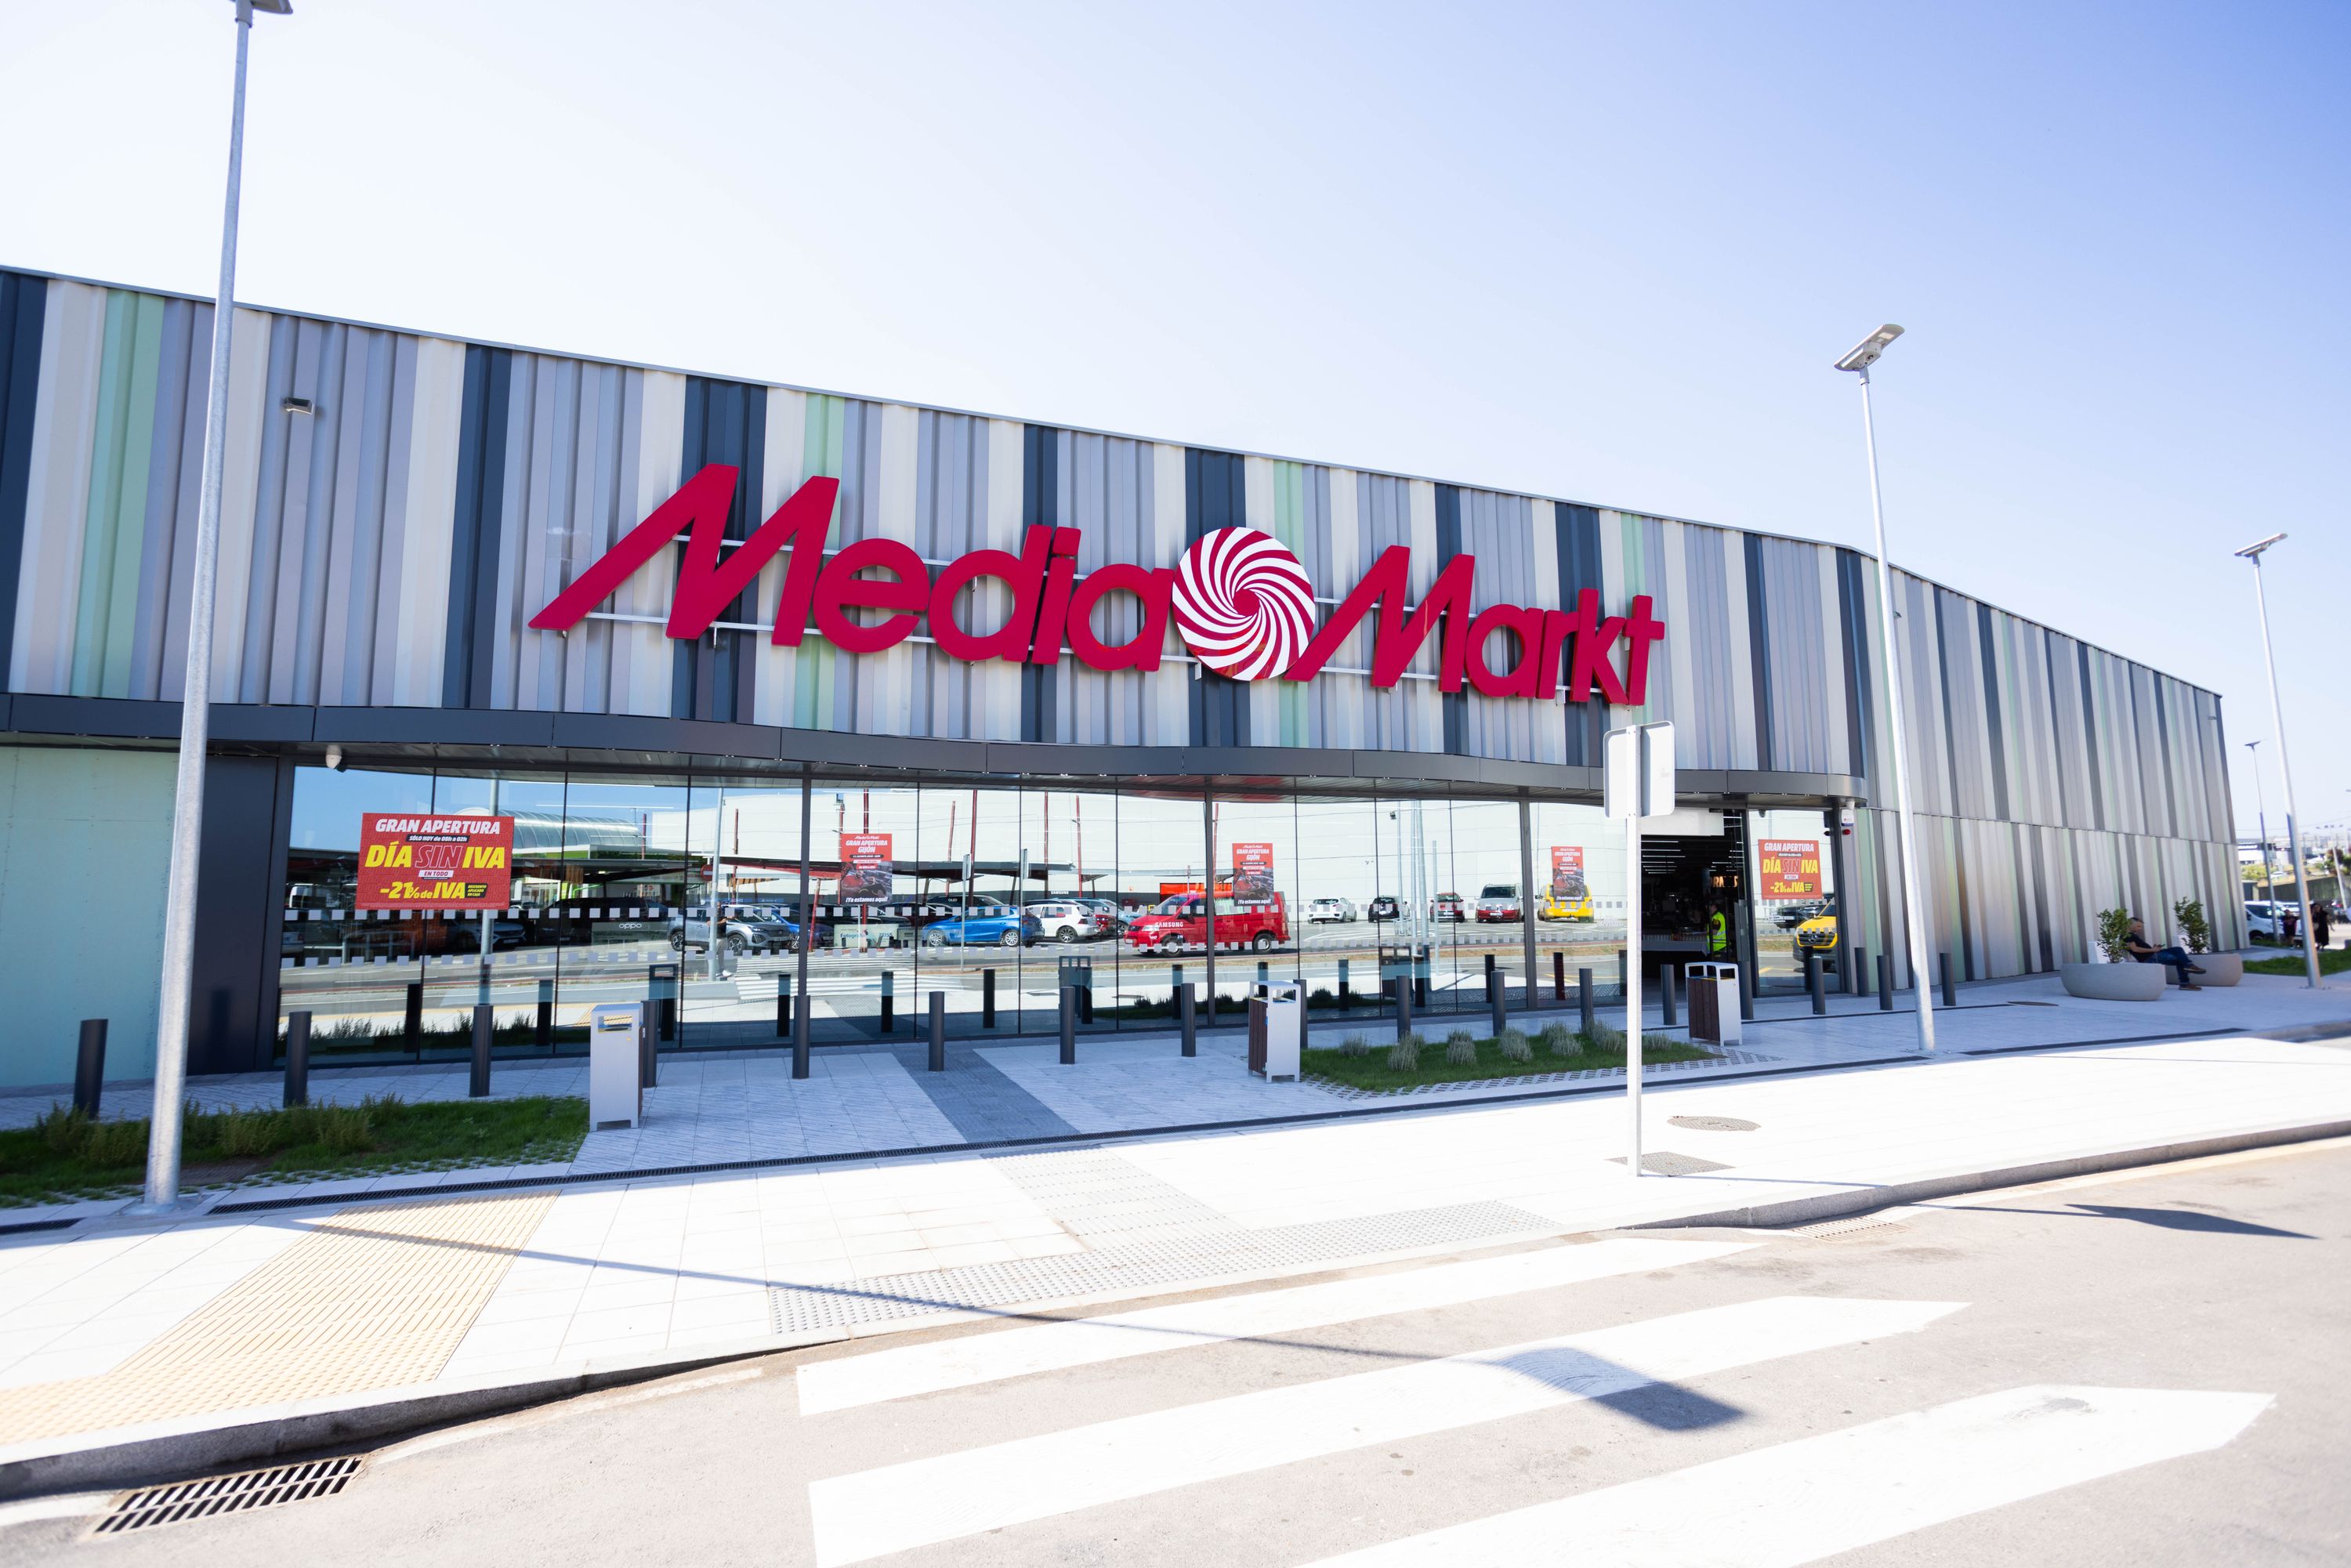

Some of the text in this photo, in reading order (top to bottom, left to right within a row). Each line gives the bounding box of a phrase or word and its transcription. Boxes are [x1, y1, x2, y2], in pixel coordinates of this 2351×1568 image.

[528, 462, 1665, 705] Media Markt
[375, 818, 500, 835] GRAN APERTURA
[364, 841, 505, 869] DÍA SIN IVA
[1764, 842, 1814, 852] GRAN APERTURA
[1762, 856, 1818, 874] DÍA SIN IVA
[380, 882, 465, 899] -21% de IVA
